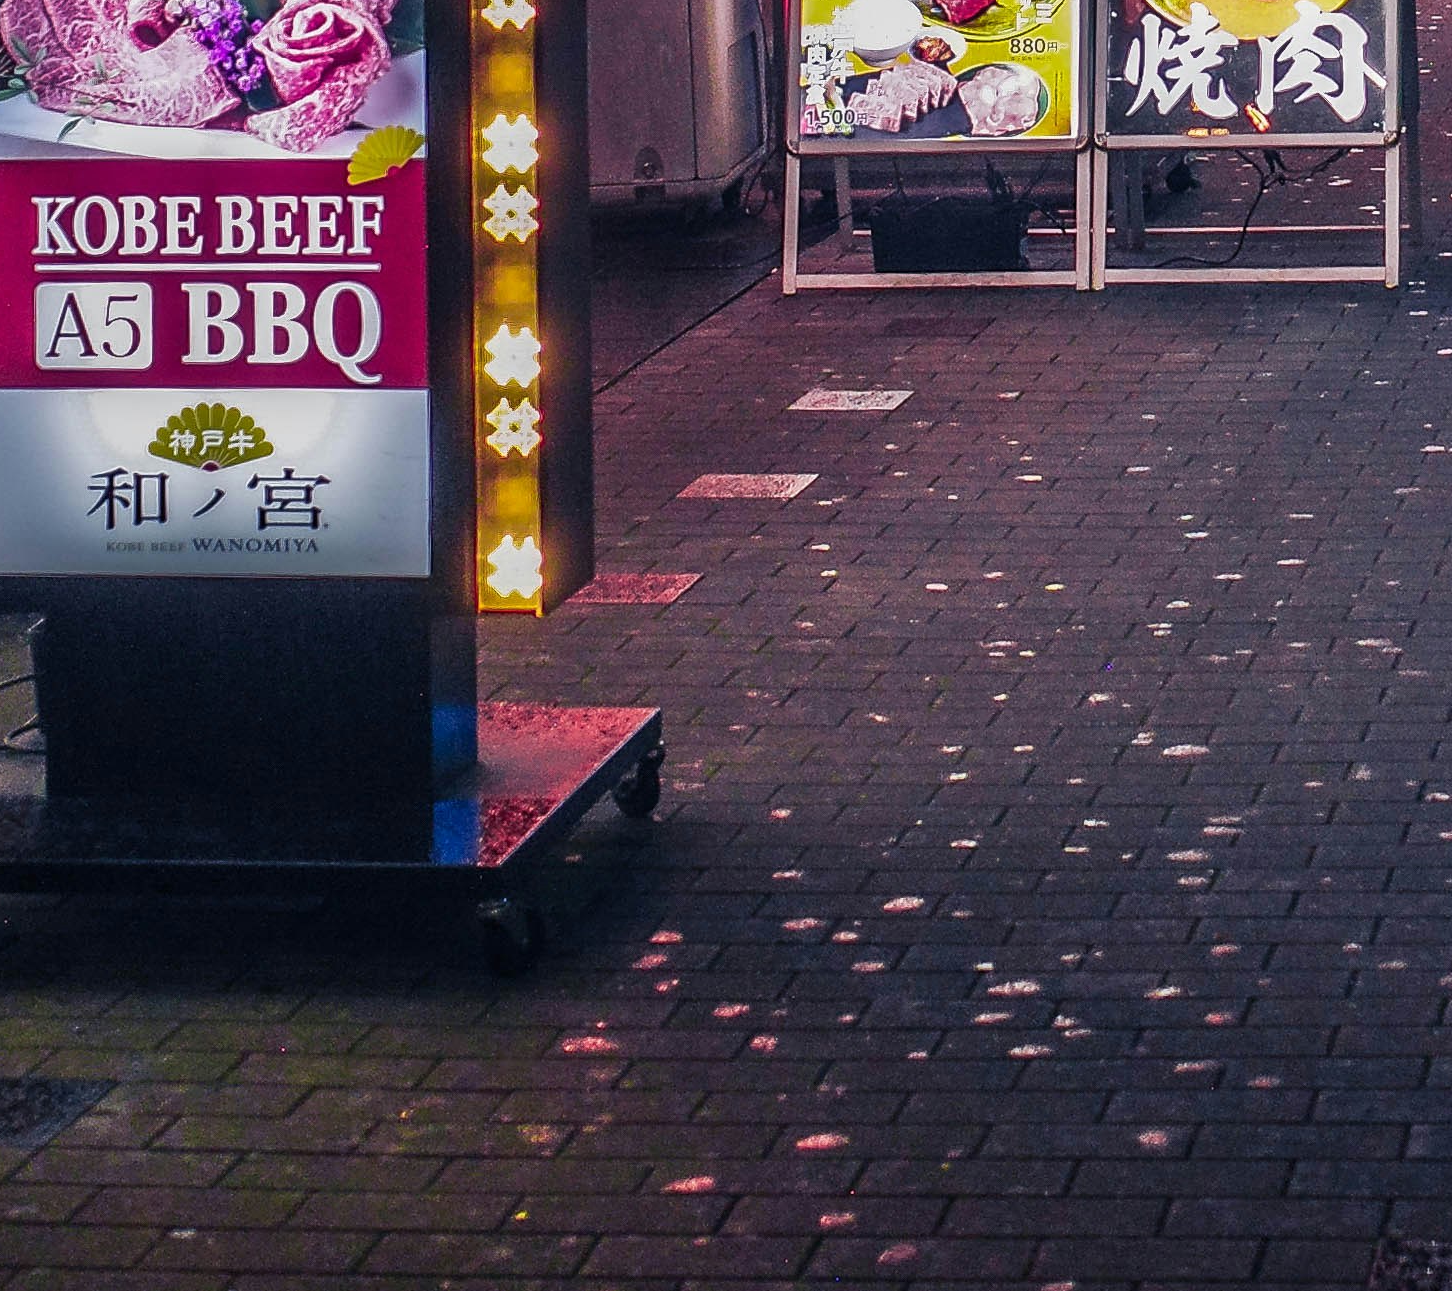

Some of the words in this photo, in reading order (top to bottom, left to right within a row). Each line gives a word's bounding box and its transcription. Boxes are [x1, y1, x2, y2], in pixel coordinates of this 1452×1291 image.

[31, 194, 205, 258] KOBE
[215, 193, 386, 257] BEEF
[44, 290, 143, 360] A5
[180, 280, 384, 385] BBQ
[169, 429, 256, 455] 神戸牛
[85, 466, 332, 532] 和ノ宮
[106, 541, 148, 553] KOBE
[151, 540, 187, 553] BEEF
[192, 536, 321, 554] WANOMIYA
